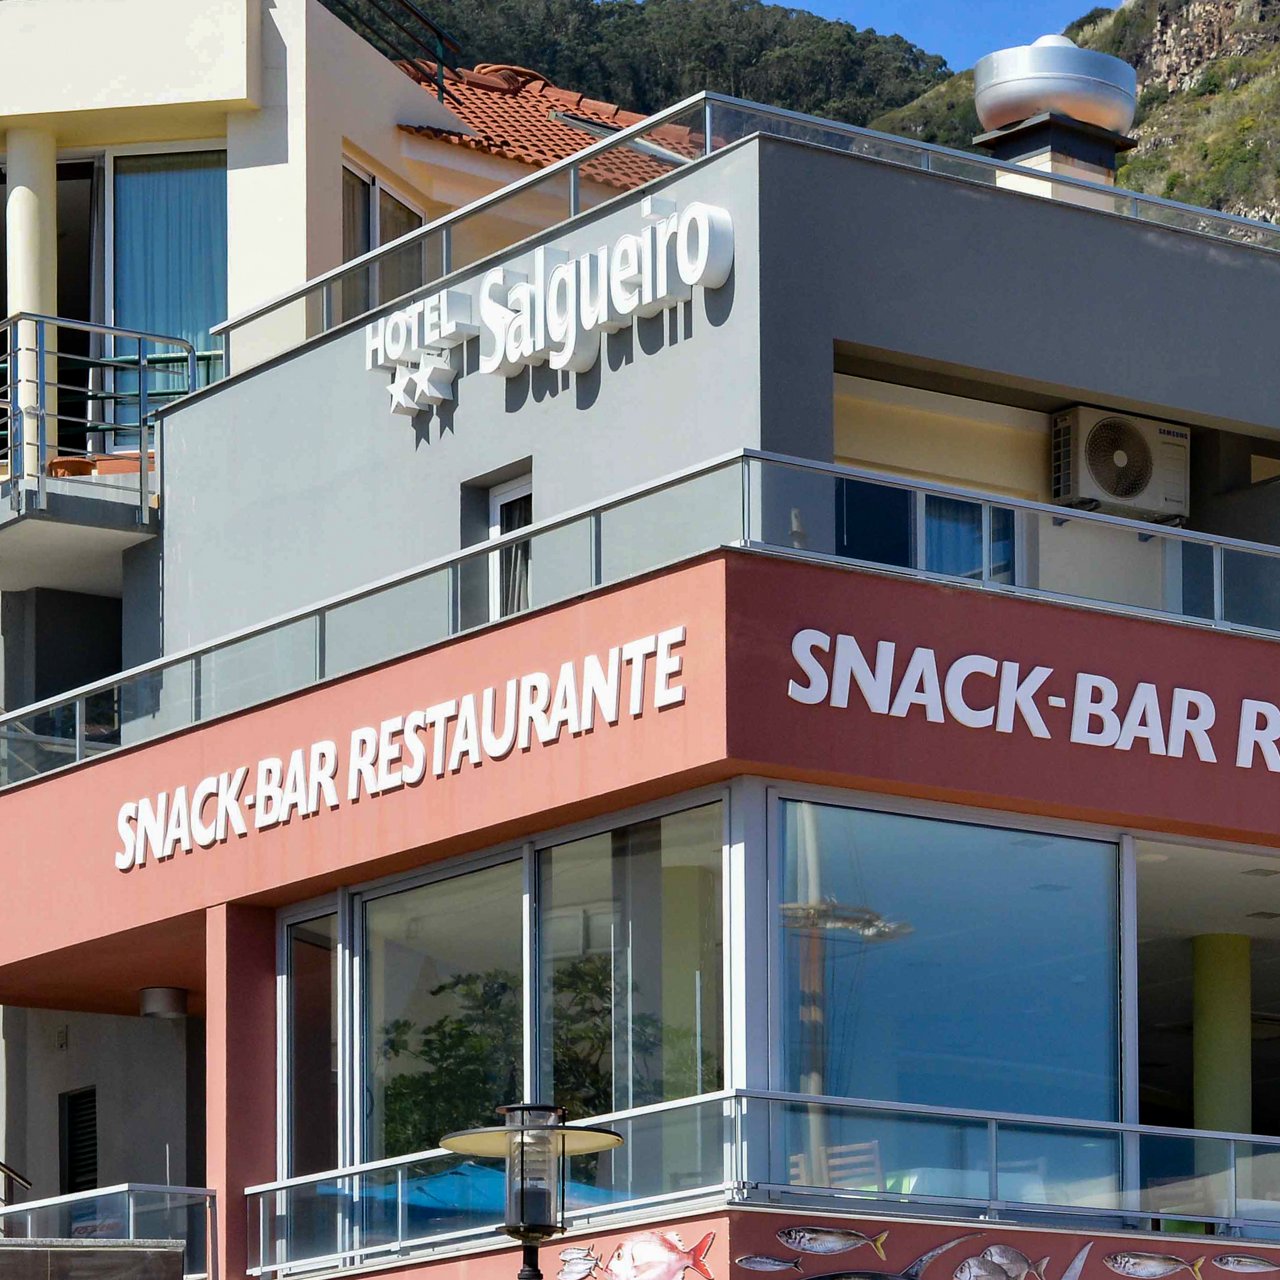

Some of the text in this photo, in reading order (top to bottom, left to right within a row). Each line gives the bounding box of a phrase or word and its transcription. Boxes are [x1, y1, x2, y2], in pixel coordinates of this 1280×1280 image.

[366, 198, 734, 377] HOTEL Salgueiro
[115, 626, 686, 872] SNACK-BAR RESTAURANTE
[788, 629, 1217, 764] SNACK-BAR
